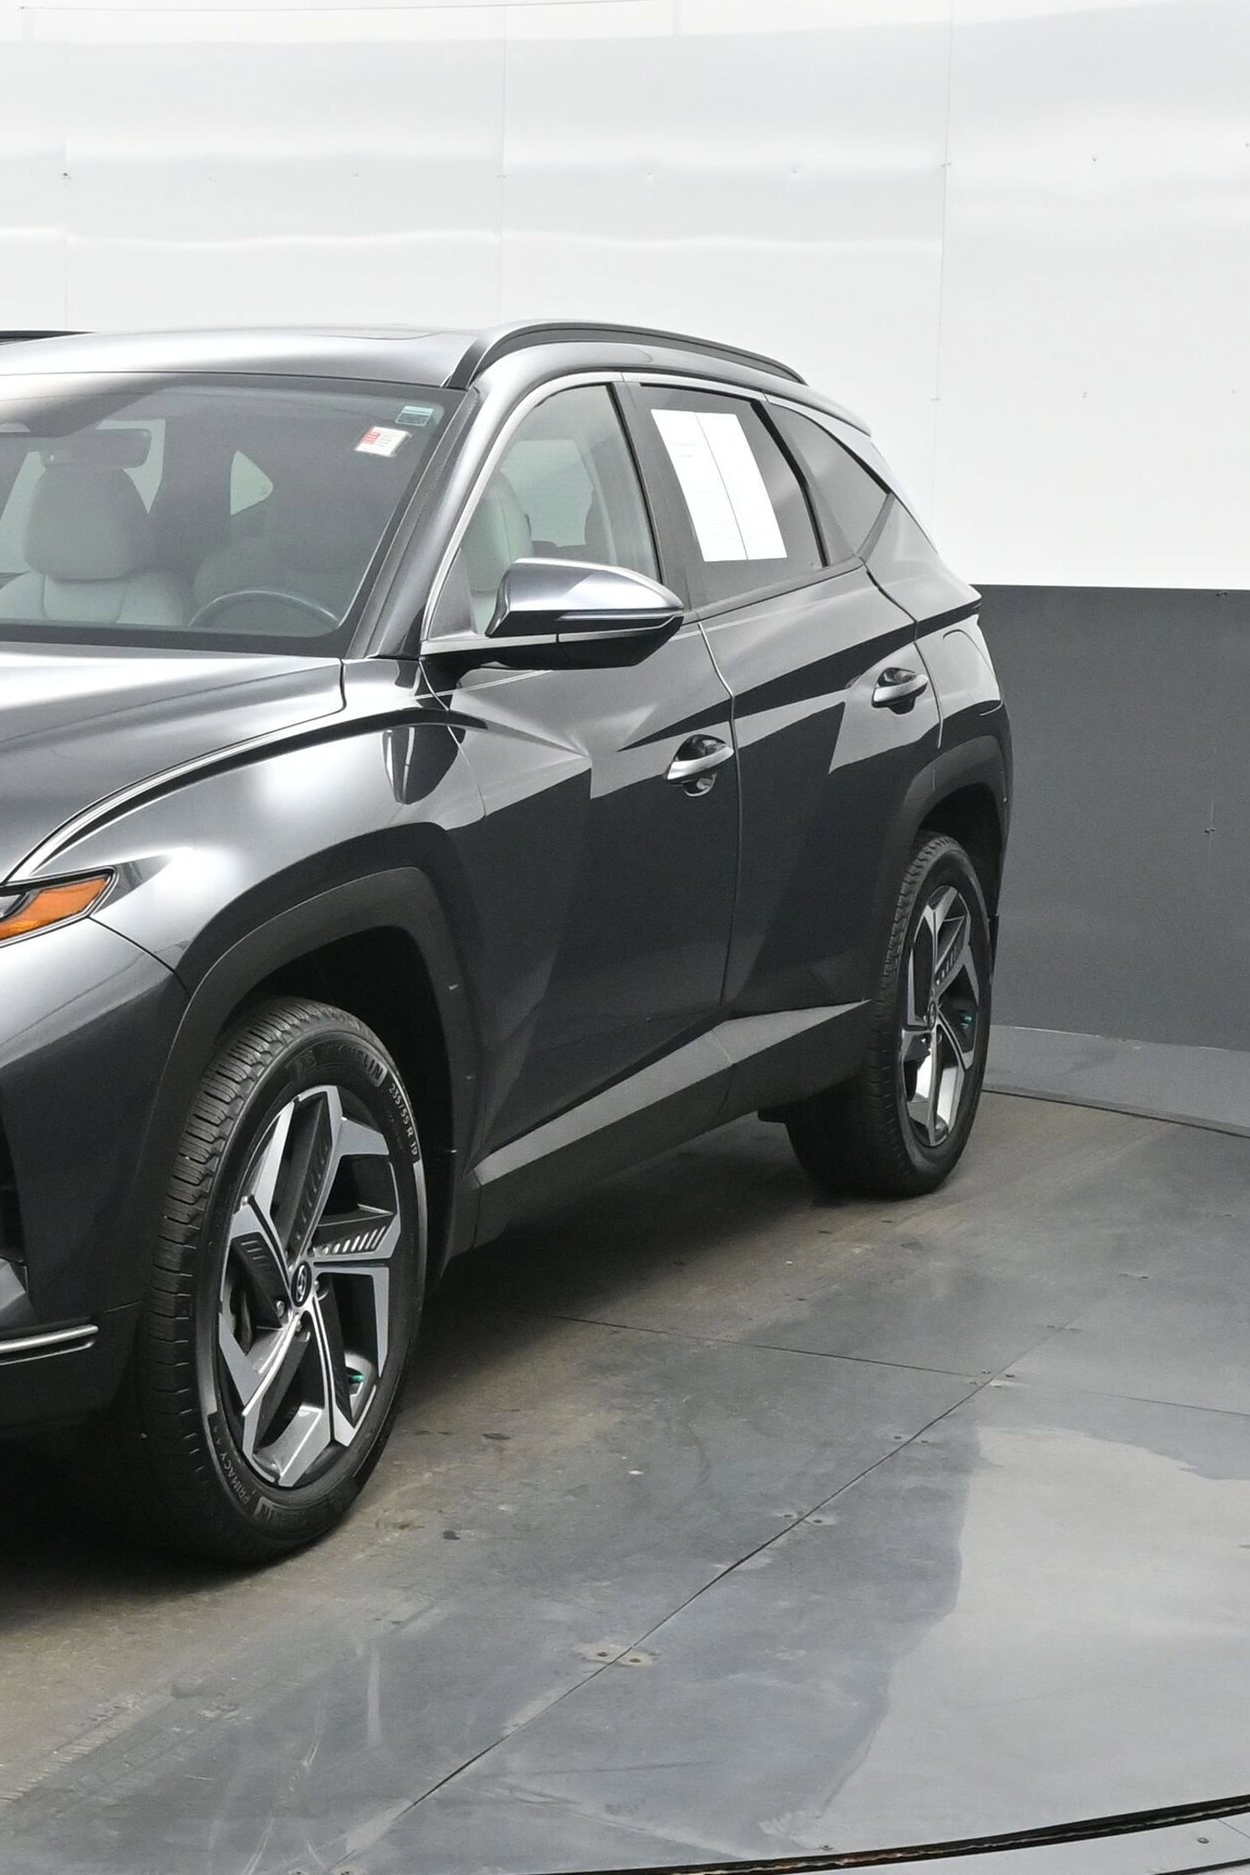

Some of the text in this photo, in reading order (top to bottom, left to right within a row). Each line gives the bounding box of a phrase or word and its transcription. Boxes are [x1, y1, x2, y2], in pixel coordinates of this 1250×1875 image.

[388, 1083, 411, 1125] 235/55
[406, 1126, 414, 1138] R
[220, 1452, 251, 1505] PRIMACY
